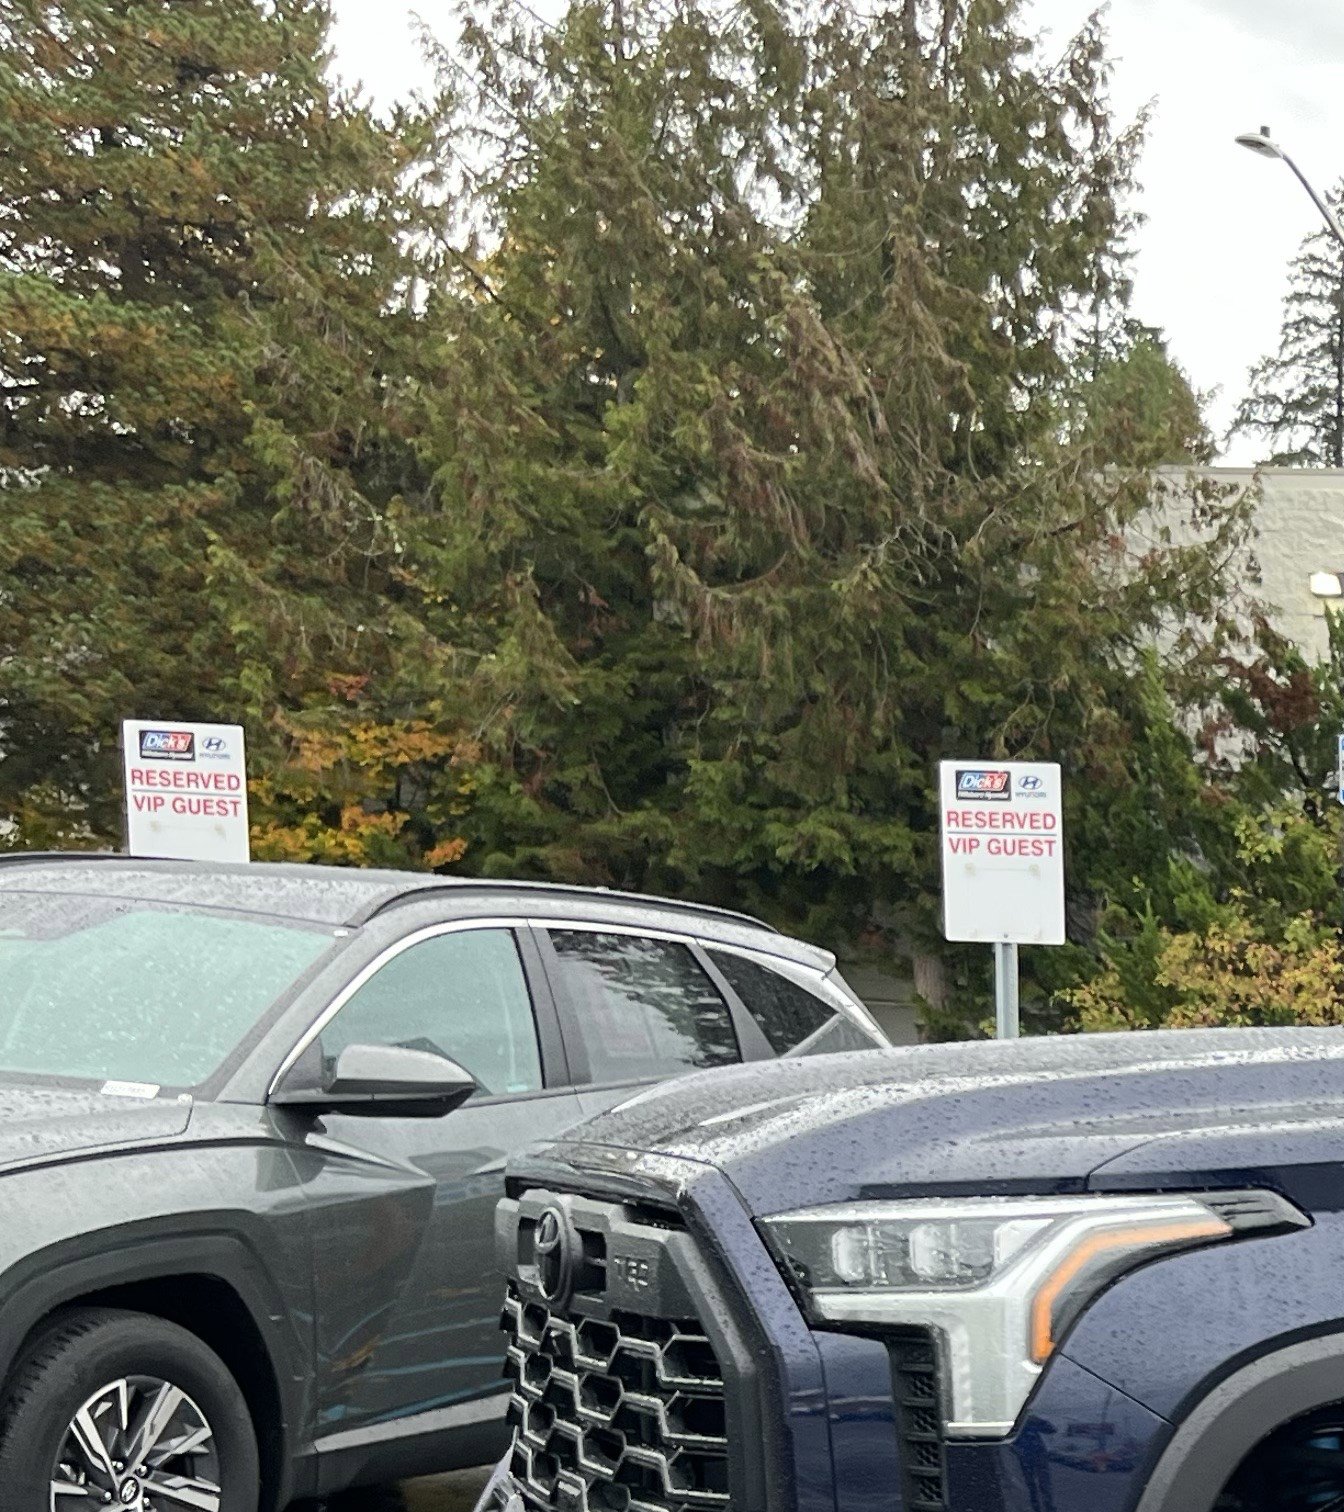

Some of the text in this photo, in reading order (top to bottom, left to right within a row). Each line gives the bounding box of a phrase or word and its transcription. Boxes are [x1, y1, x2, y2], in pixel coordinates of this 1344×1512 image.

[131, 769, 241, 791] RESERVED
[133, 795, 241, 817] VIP GUEST
[947, 811, 1057, 830] RESERVED
[949, 838, 1057, 857] VIP GUEST
